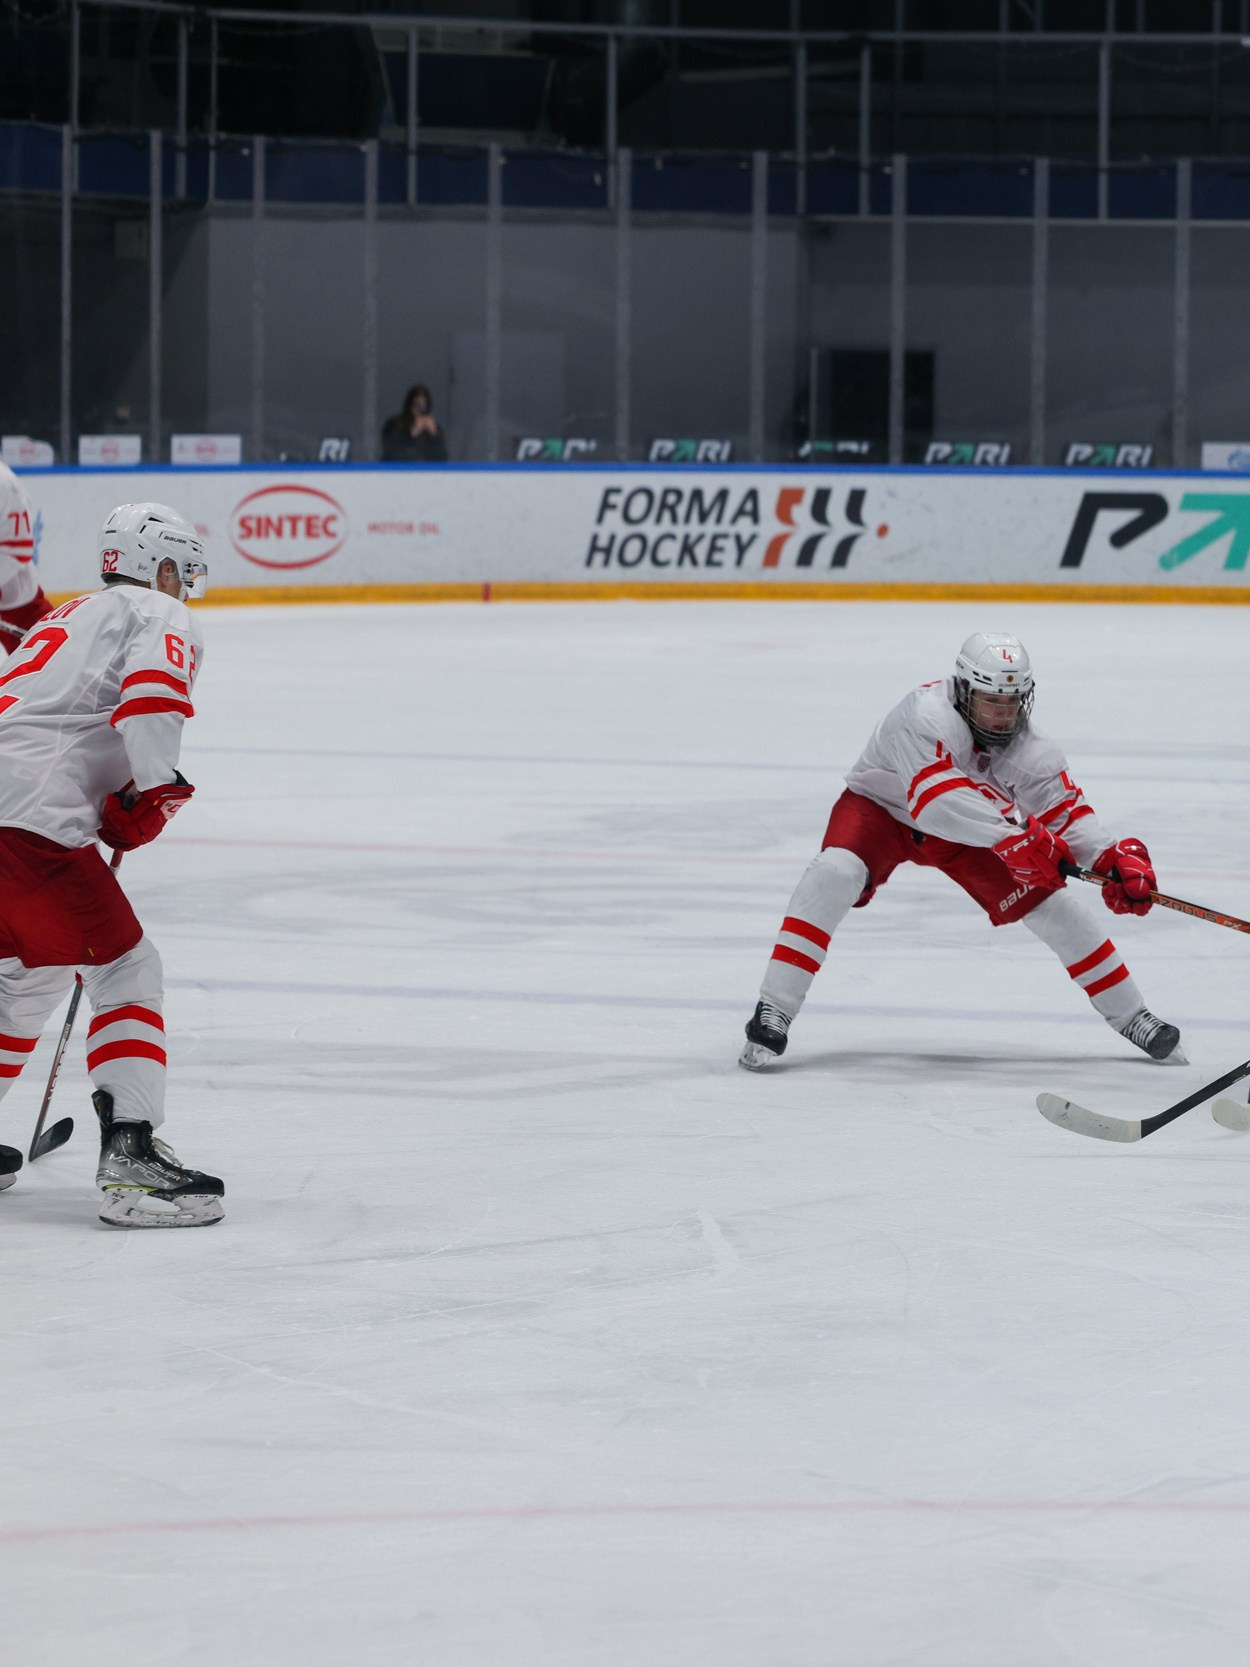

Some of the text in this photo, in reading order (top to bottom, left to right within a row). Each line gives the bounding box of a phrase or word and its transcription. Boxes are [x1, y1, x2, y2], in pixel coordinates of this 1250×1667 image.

[319, 437, 349, 461] RI
[649, 439, 732, 461] PARI
[924, 442, 1011, 465] PARI
[1065, 444, 1153, 467] PARI
[596, 487, 761, 526] FORMA
[8, 510, 31, 537] 71
[238, 513, 339, 540] SINTEC
[102, 550, 118, 573] 62
[585, 532, 760, 568] HOCKEY
[1002, 649, 1013, 663] 4
[999, 883, 1036, 913] BAU
[109, 1153, 170, 1189] VAPOR
